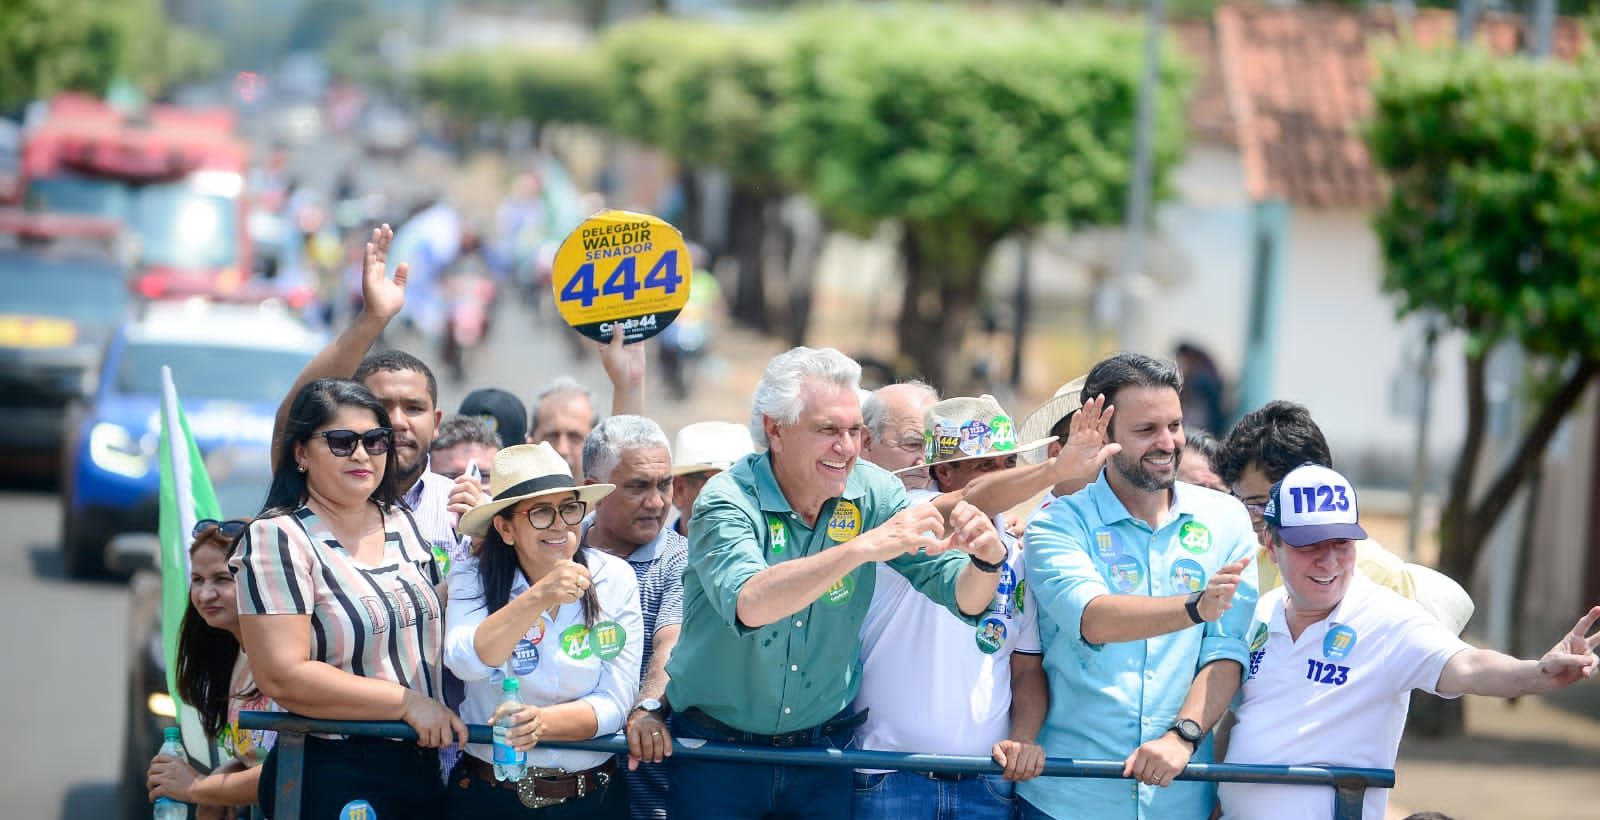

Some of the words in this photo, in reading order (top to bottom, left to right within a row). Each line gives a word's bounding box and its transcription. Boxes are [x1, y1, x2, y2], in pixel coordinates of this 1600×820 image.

[582, 221, 651, 238] DELEGADO
[583, 230, 651, 250] WALDIR
[586, 242, 652, 260] SENADOR
[560, 249, 683, 307] 444
[639, 314, 656, 326] 44
[941, 436, 959, 446] 444
[1289, 484, 1350, 514] 1123
[829, 518, 856, 530] 444
[1181, 530, 1209, 550] 44
[598, 628, 617, 646] 111
[1307, 658, 1351, 686] 1123
